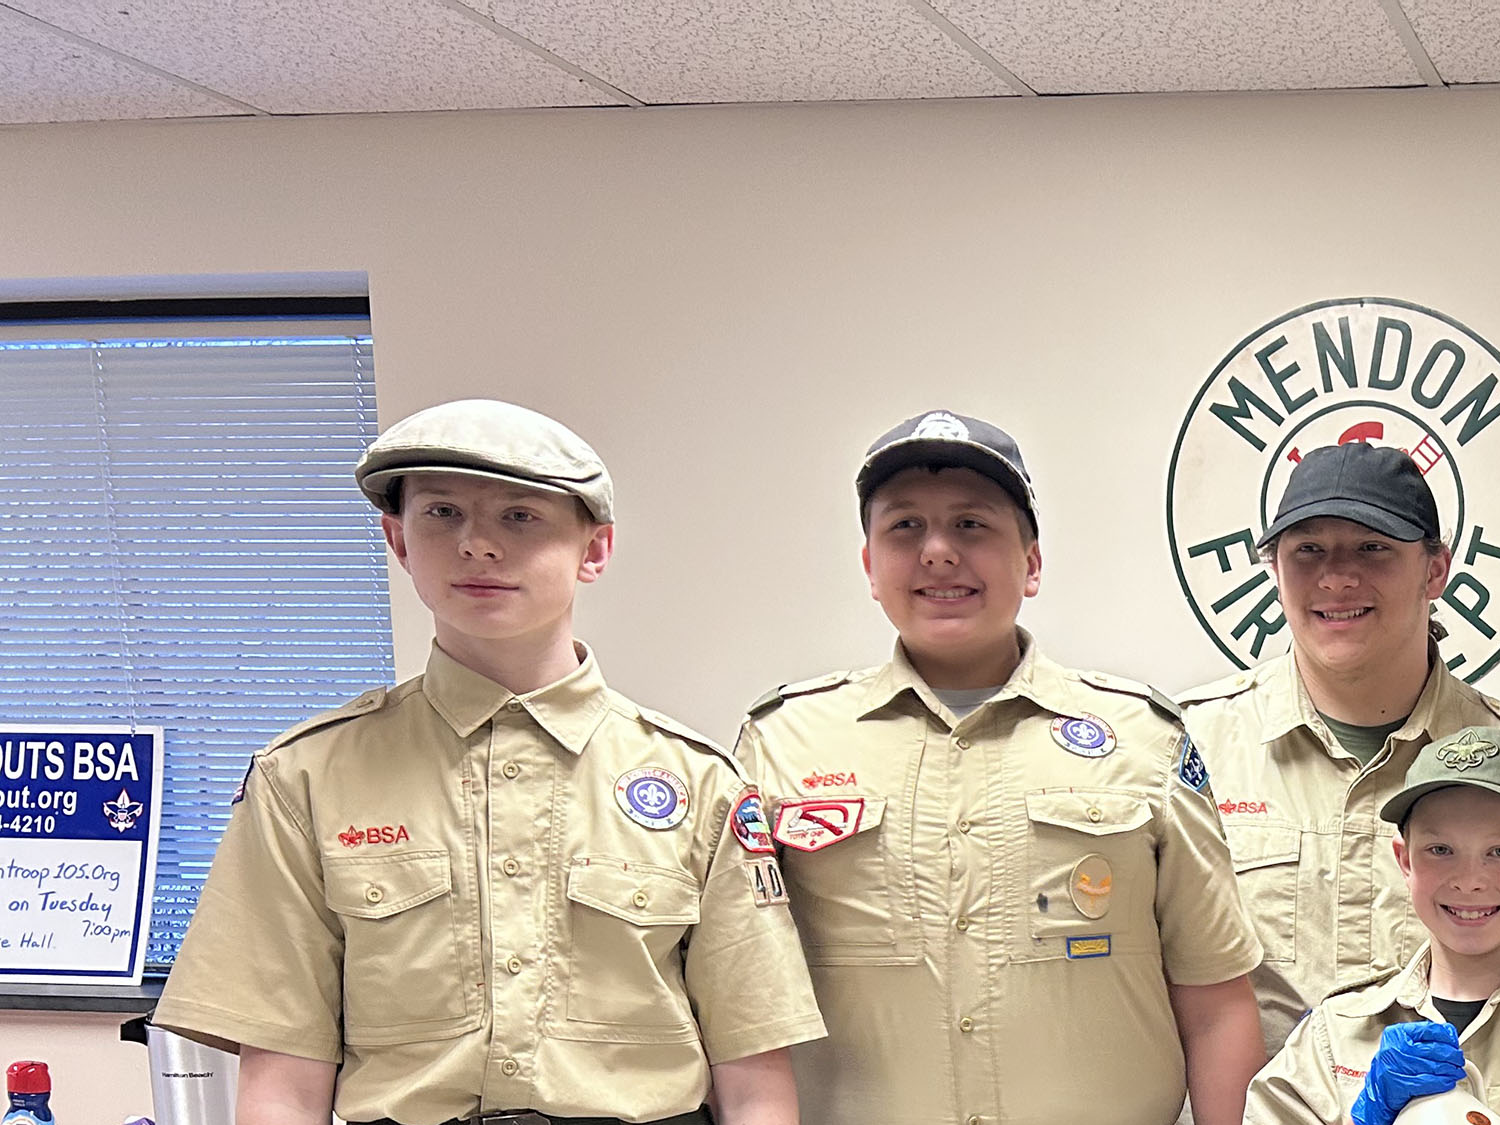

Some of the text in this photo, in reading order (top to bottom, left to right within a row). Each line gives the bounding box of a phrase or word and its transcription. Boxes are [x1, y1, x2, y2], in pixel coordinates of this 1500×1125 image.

[1188, 528, 1288, 660] FIR
[0, 740, 140, 782] UTS BSA
[823, 772, 858, 788] BSA
[1236, 801, 1268, 815] BSA
[0, 814, 56, 834] -4210
[366, 825, 410, 845] BSA
[8, 891, 113, 922] on Tuesday
